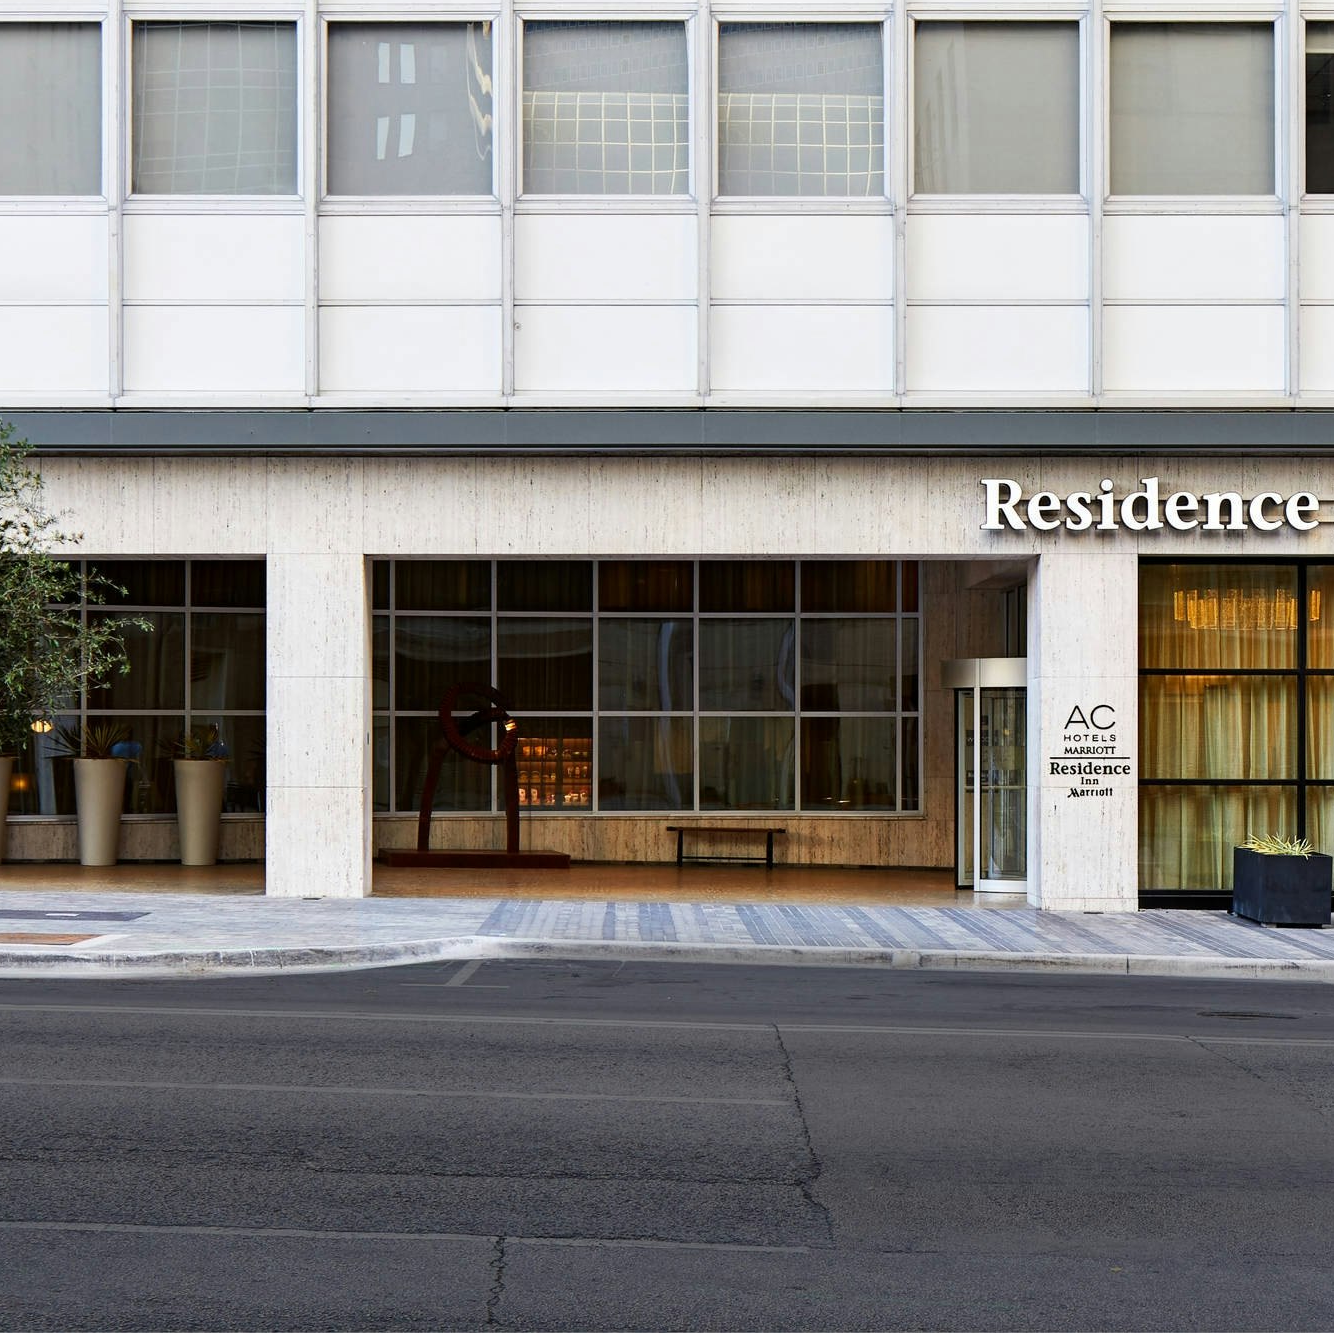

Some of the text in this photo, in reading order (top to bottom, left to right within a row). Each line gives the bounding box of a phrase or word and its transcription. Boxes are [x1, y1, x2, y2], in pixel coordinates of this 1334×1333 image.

[980, 476, 1320, 531] Residence
[1064, 704, 1116, 730] AC
[1063, 734, 1117, 742] HOTELS
[1063, 746, 1116, 755] MARRIOTT
[1049, 762, 1131, 775] Residence
[1080, 776, 1099, 785] Inn
[1067, 787, 1113, 798] Marriott
